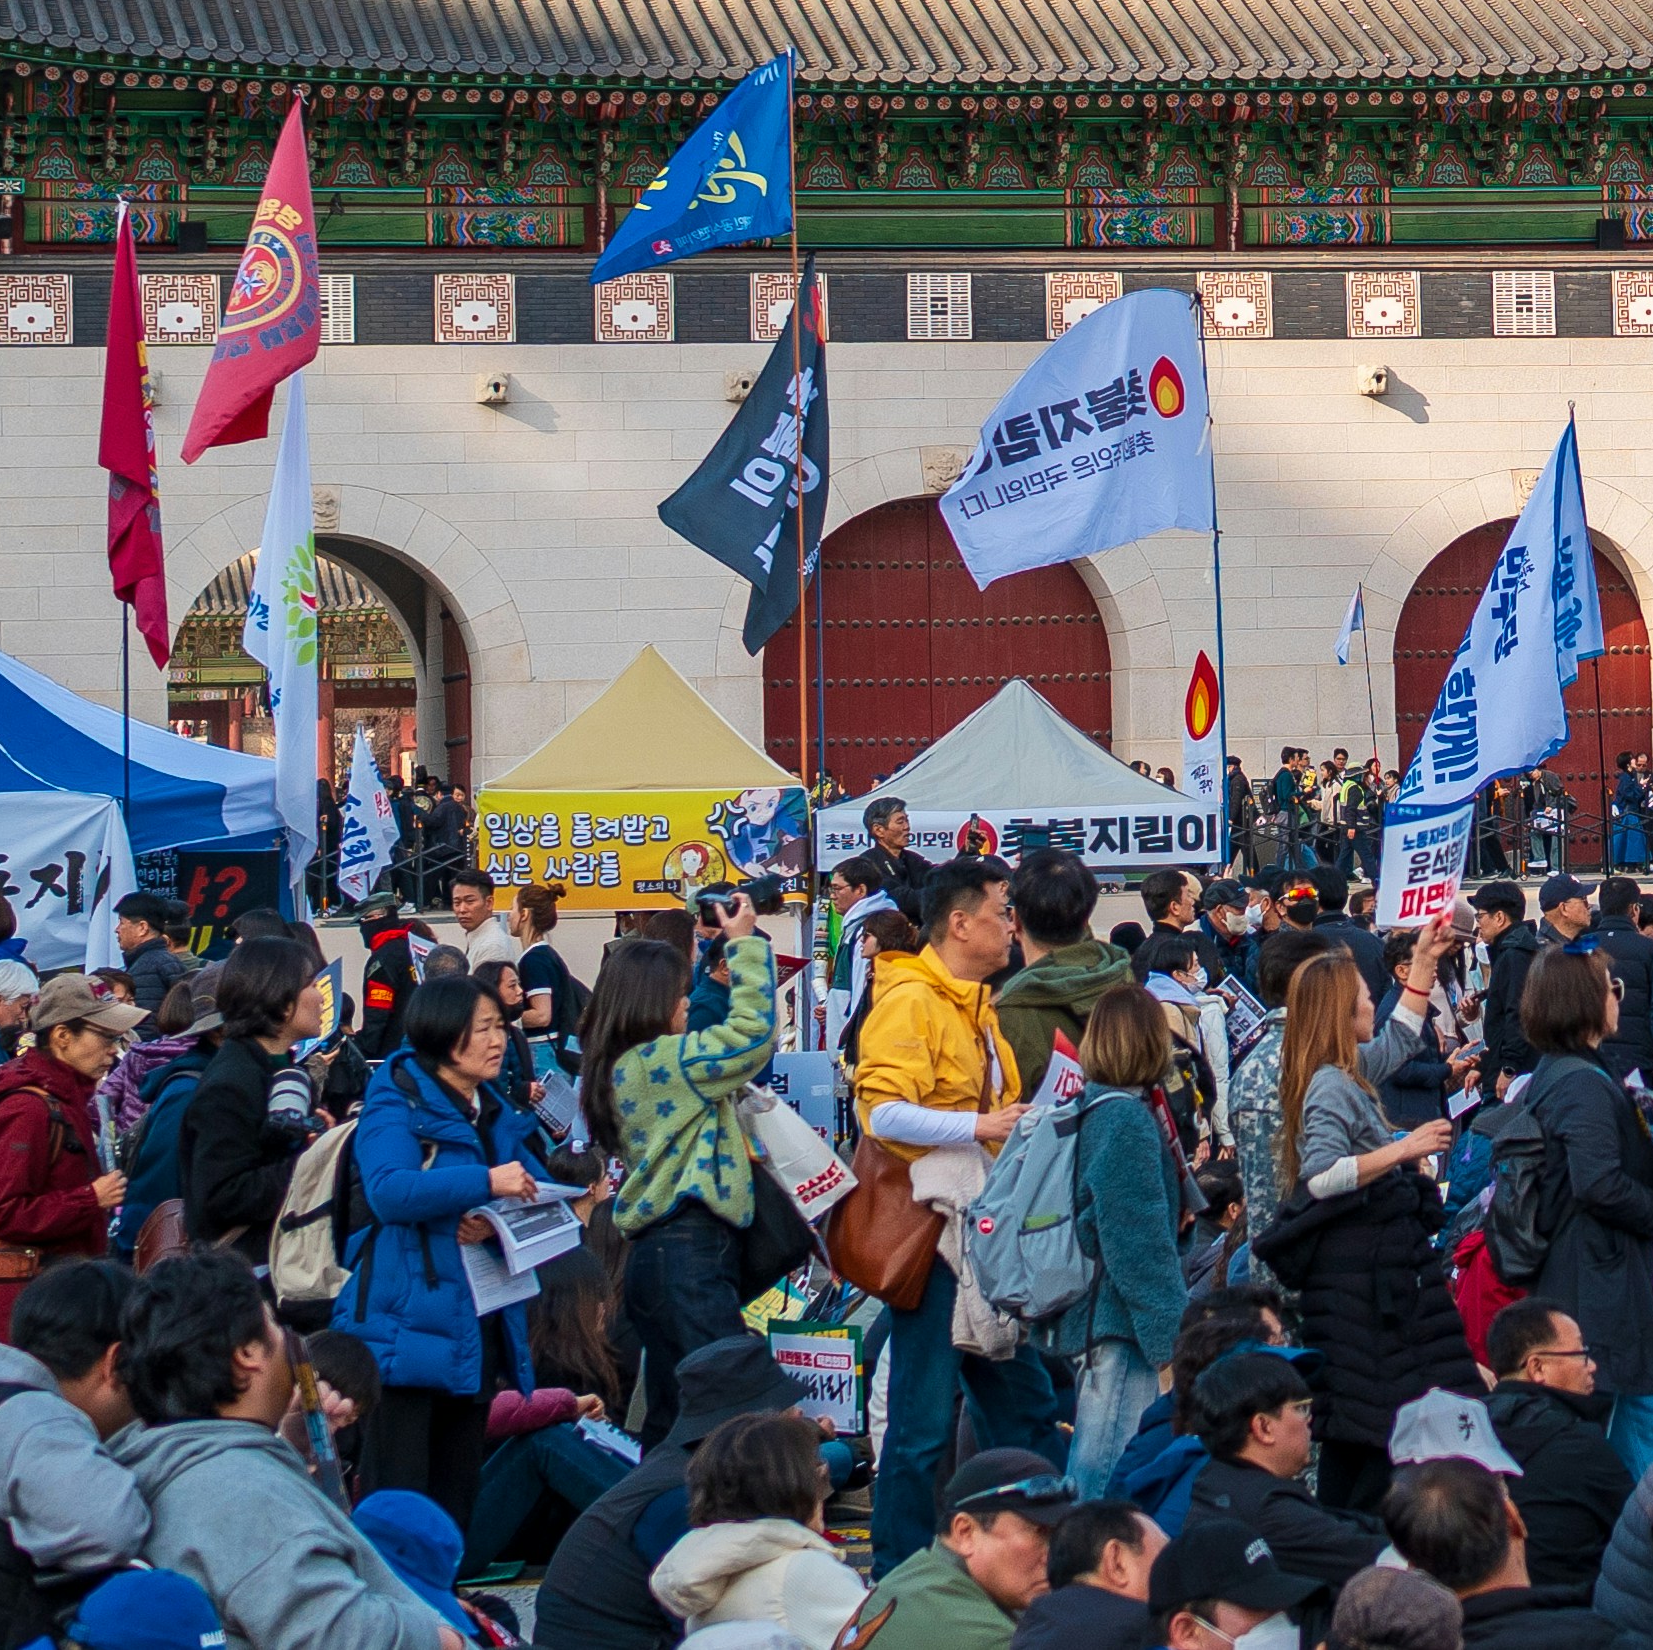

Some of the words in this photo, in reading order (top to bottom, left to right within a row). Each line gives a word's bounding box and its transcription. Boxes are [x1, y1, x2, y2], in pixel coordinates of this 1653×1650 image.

[484, 812, 561, 848] 일상을
[570, 812, 670, 848] 돌려받고
[485, 852, 534, 887] 싶은
[543, 850, 622, 888] 사람들
